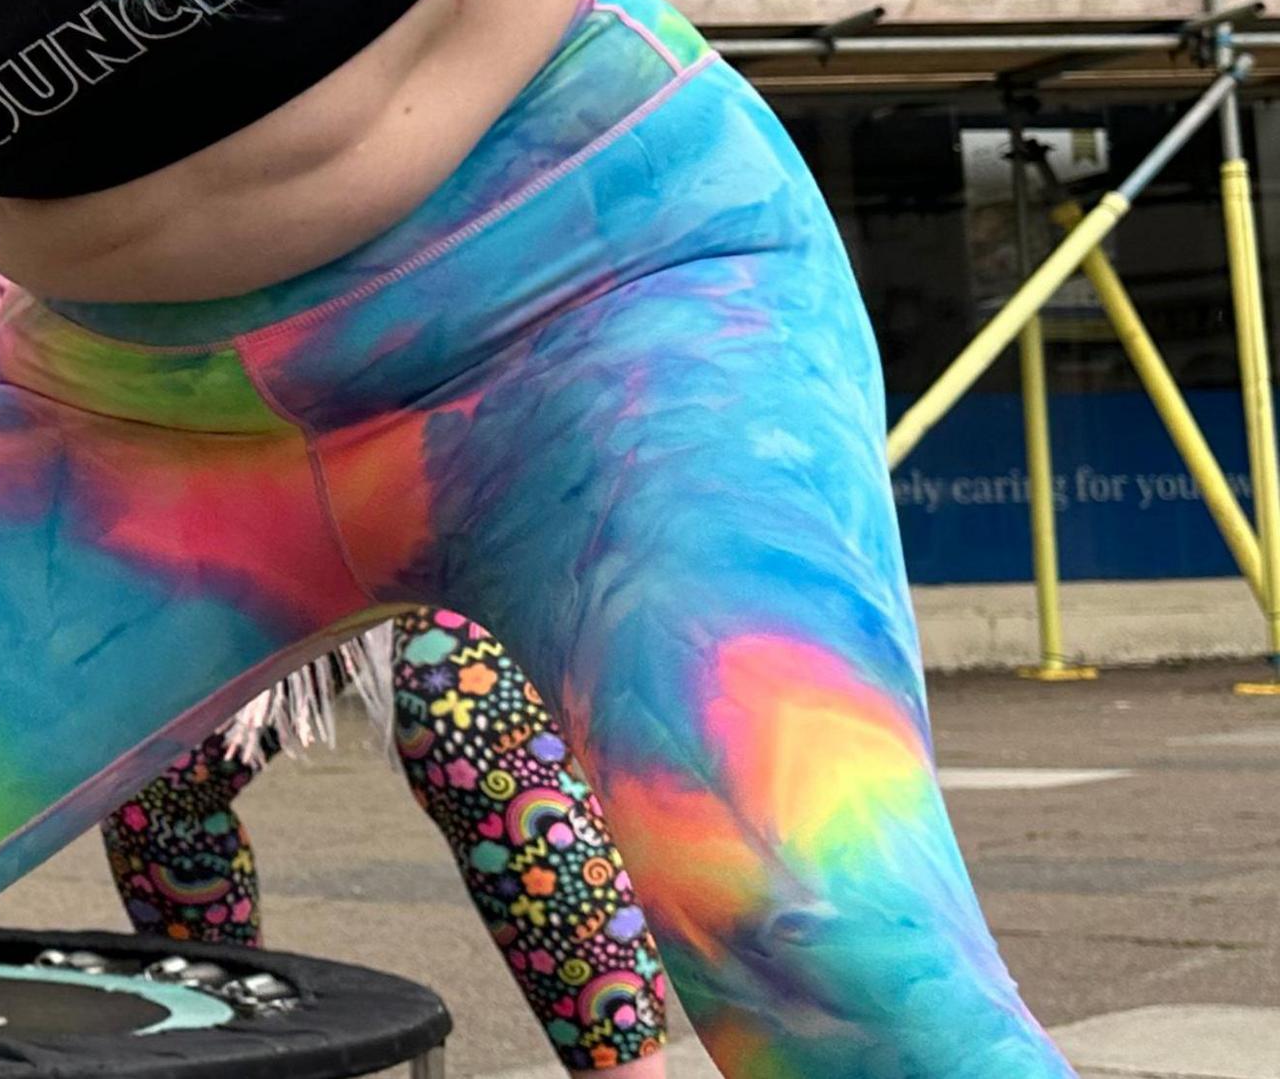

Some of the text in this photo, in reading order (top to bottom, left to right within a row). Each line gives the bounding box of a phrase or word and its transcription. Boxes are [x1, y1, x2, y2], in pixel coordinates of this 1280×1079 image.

[892, 468, 940, 514] ely
[951, 466, 1069, 512] carig
[1075, 464, 1128, 503] for
[1135, 472, 1202, 510] you
